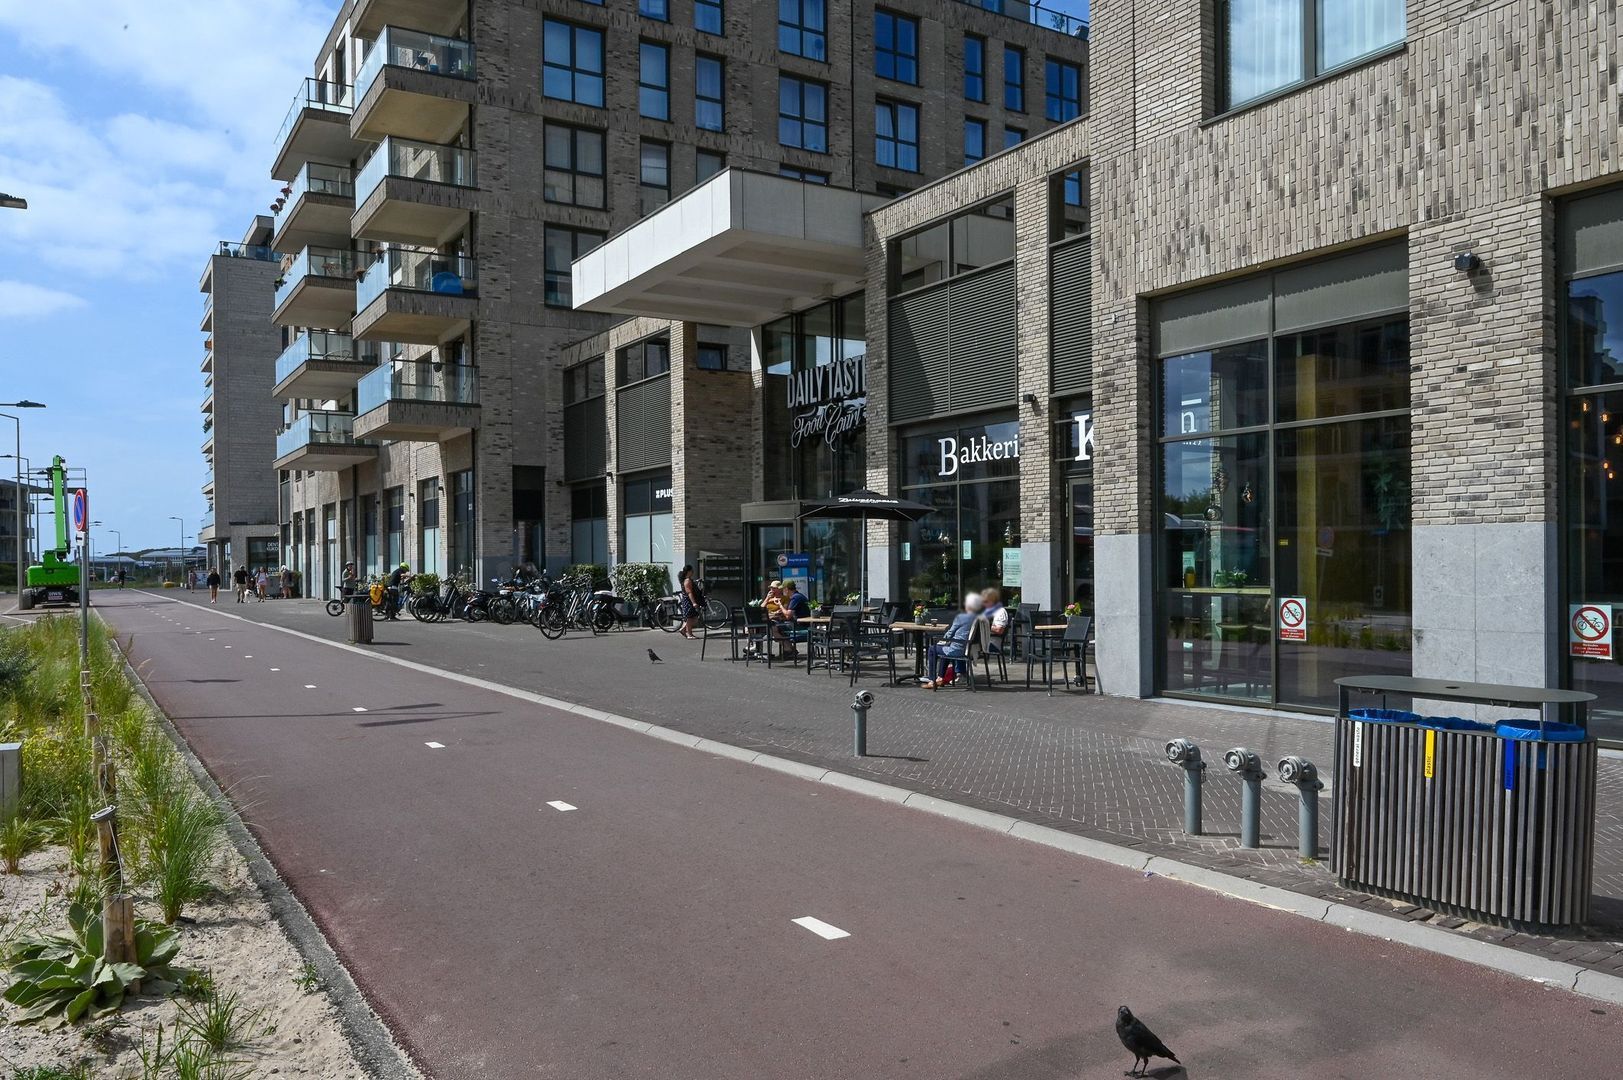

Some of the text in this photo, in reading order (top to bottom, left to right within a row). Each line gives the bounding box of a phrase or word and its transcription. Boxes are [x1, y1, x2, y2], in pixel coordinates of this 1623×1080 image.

[787, 365, 824, 409] DAILY
[791, 401, 866, 452] Food Court
[938, 434, 1020, 476] Bakkeri
